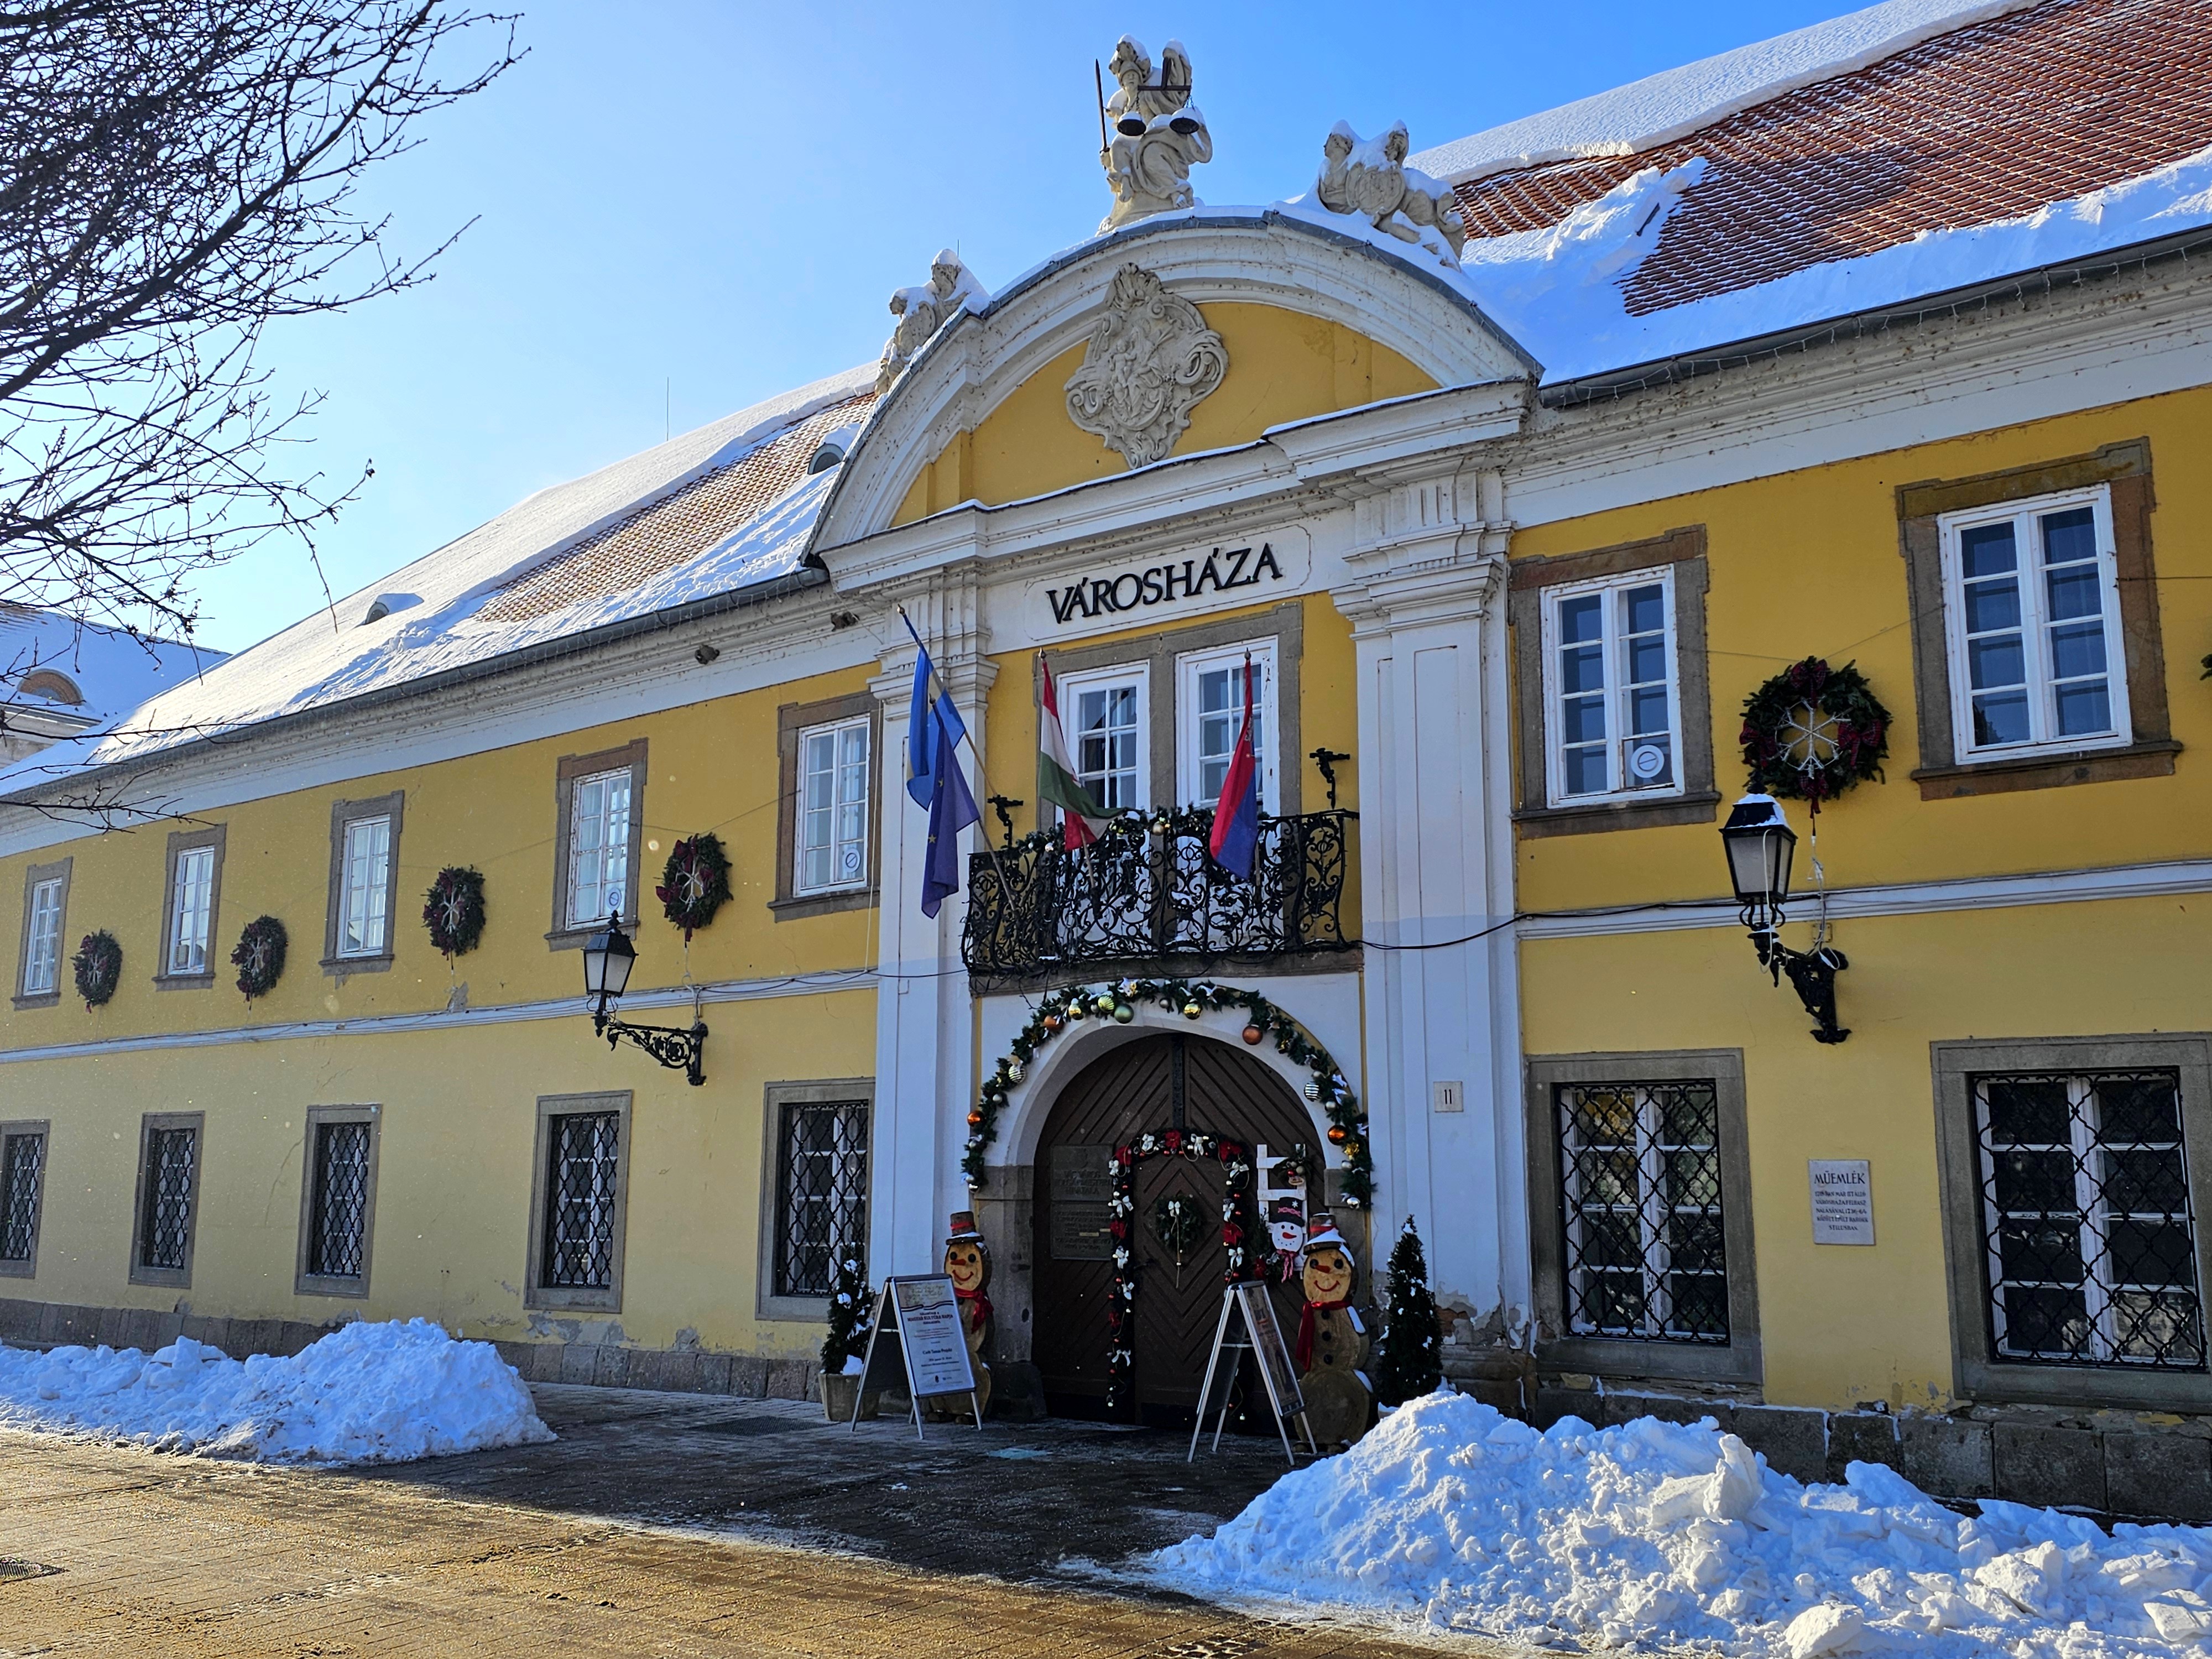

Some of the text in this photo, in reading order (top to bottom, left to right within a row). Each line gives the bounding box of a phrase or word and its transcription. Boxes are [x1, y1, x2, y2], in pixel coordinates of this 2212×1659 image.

[1046, 542, 1283, 624] VÁROSHÁZA
[1444, 1089, 1452, 1104] 11
[1814, 1170, 1865, 1185] MŰEMLÉK
